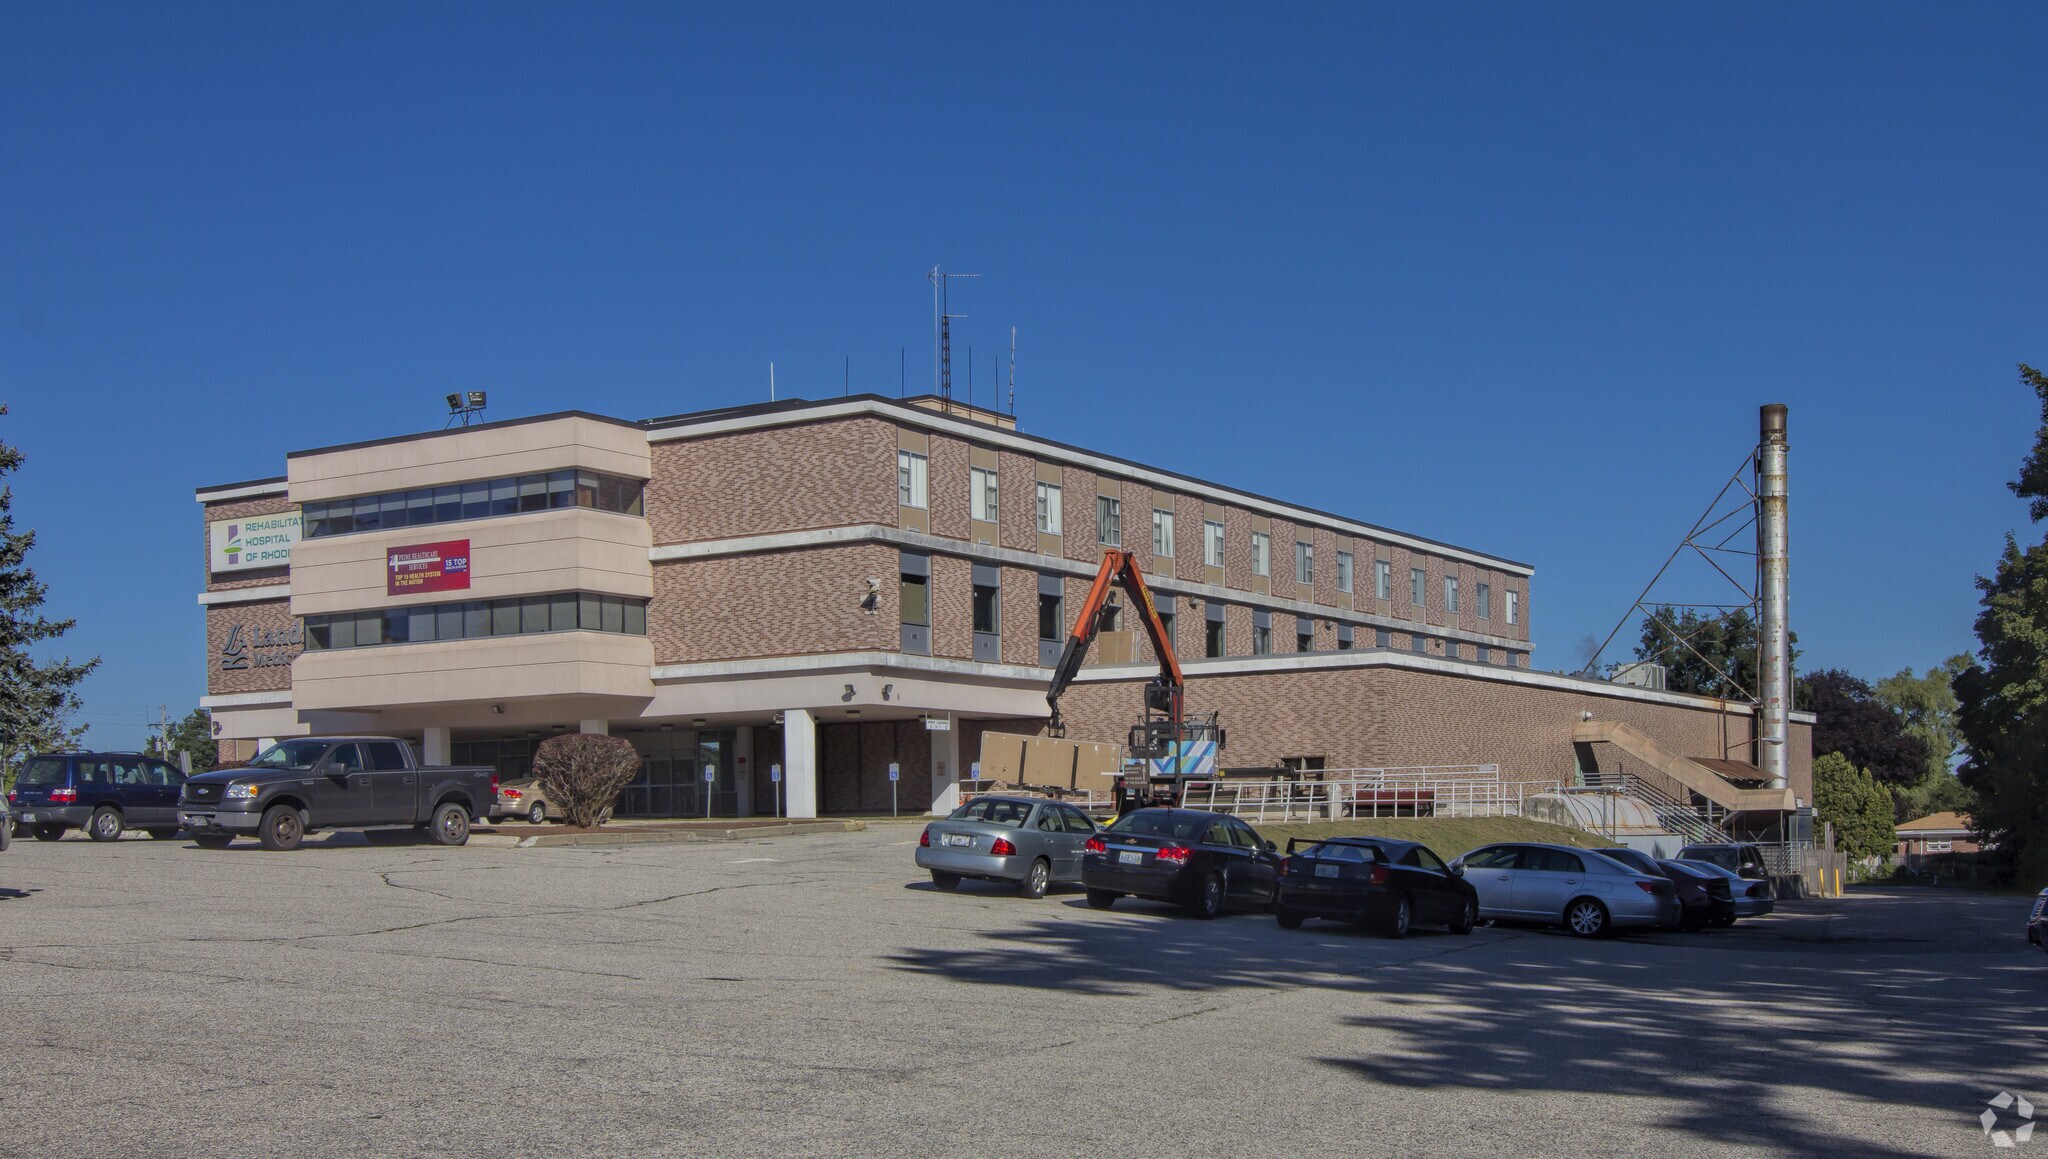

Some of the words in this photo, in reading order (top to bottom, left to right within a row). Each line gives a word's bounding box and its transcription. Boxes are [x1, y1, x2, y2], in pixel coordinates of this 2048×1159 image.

[245, 534, 290, 547] HOSPITAL
[245, 552, 258, 562] OF
[412, 551, 438, 560] HEALTHCARE
[409, 562, 428, 570] SERVICES
[445, 559, 452, 567] 15
[453, 557, 467, 566] TOP
[253, 618, 304, 648] Land
